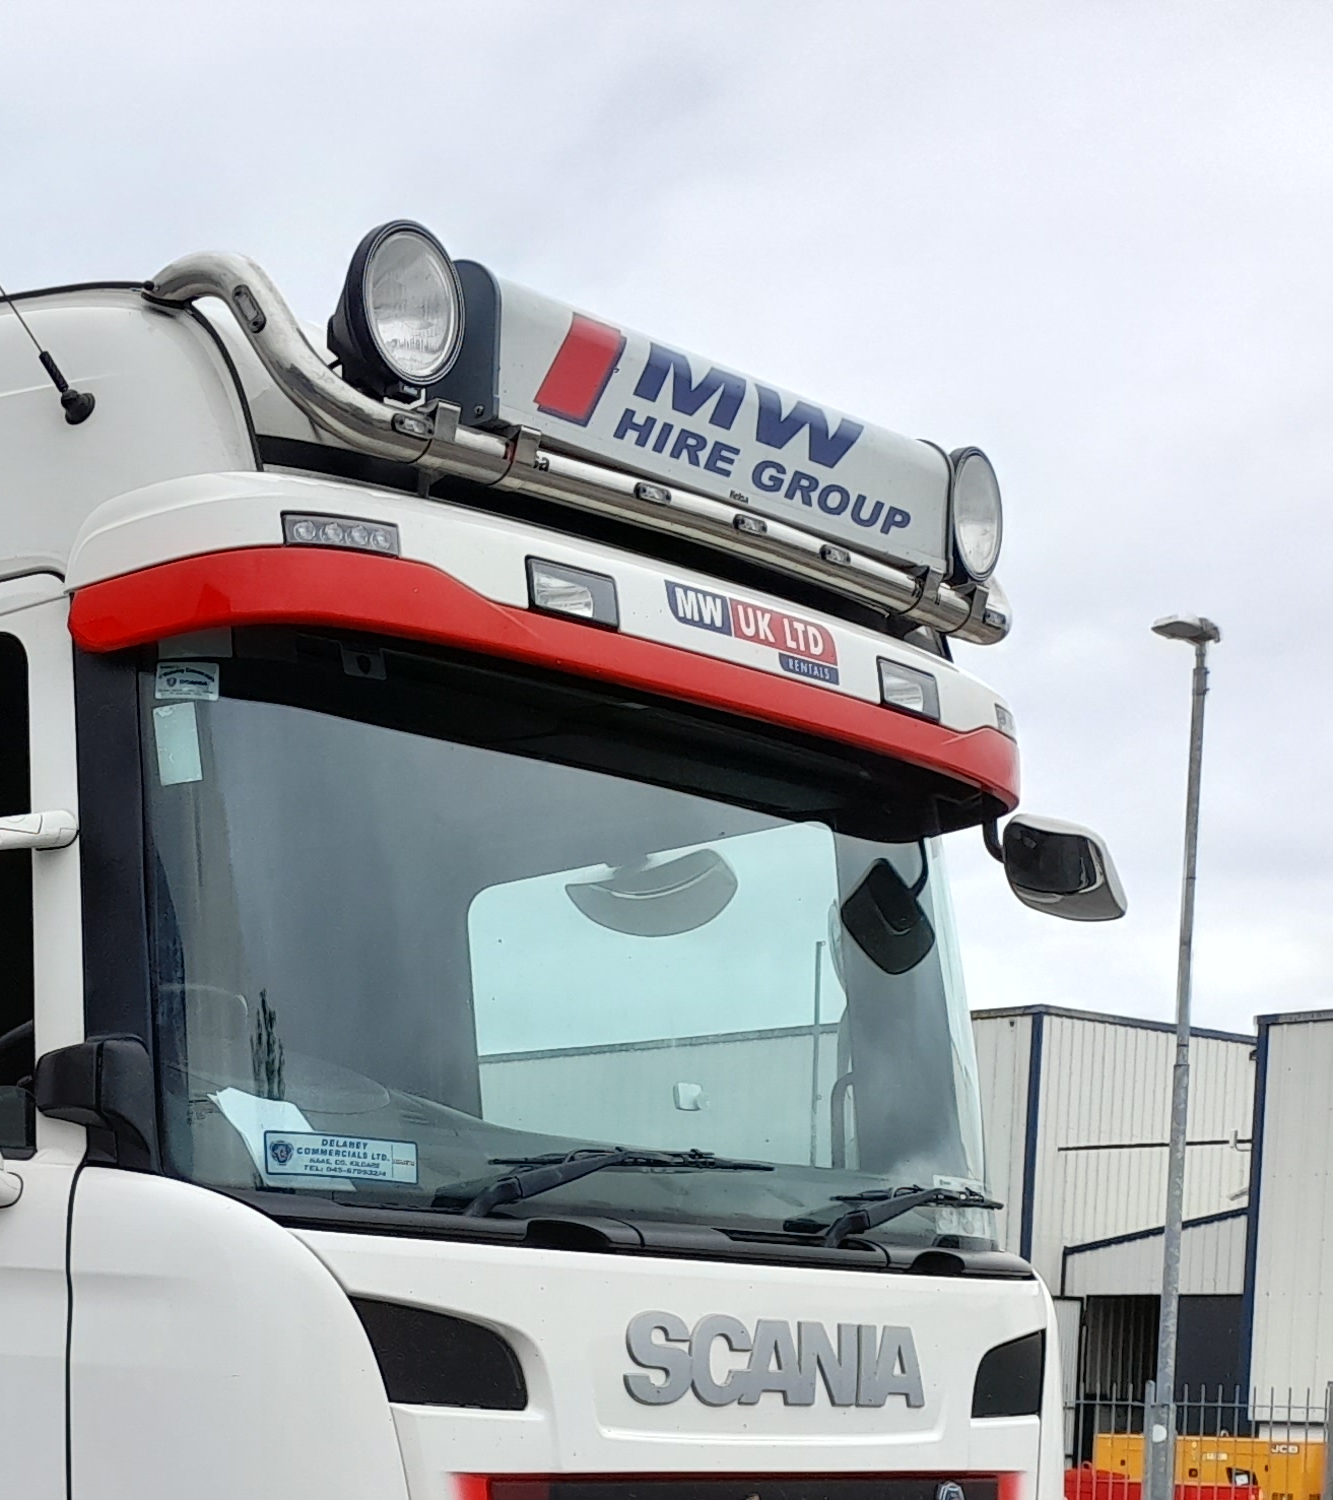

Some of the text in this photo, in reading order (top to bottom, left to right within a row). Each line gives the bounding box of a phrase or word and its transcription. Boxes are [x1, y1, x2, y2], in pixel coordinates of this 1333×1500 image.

[633, 342, 864, 469] MW
[613, 408, 912, 535] HIRE GROUP
[674, 586, 824, 656] MW UK LTD
[788, 658, 831, 680] RENTALS
[296, 1147, 368, 1160] COMMERCIALS
[321, 1139, 369, 1150] DELANEY
[623, 1309, 926, 1408] SCANIA
[1271, 1444, 1299, 1454] JCB
